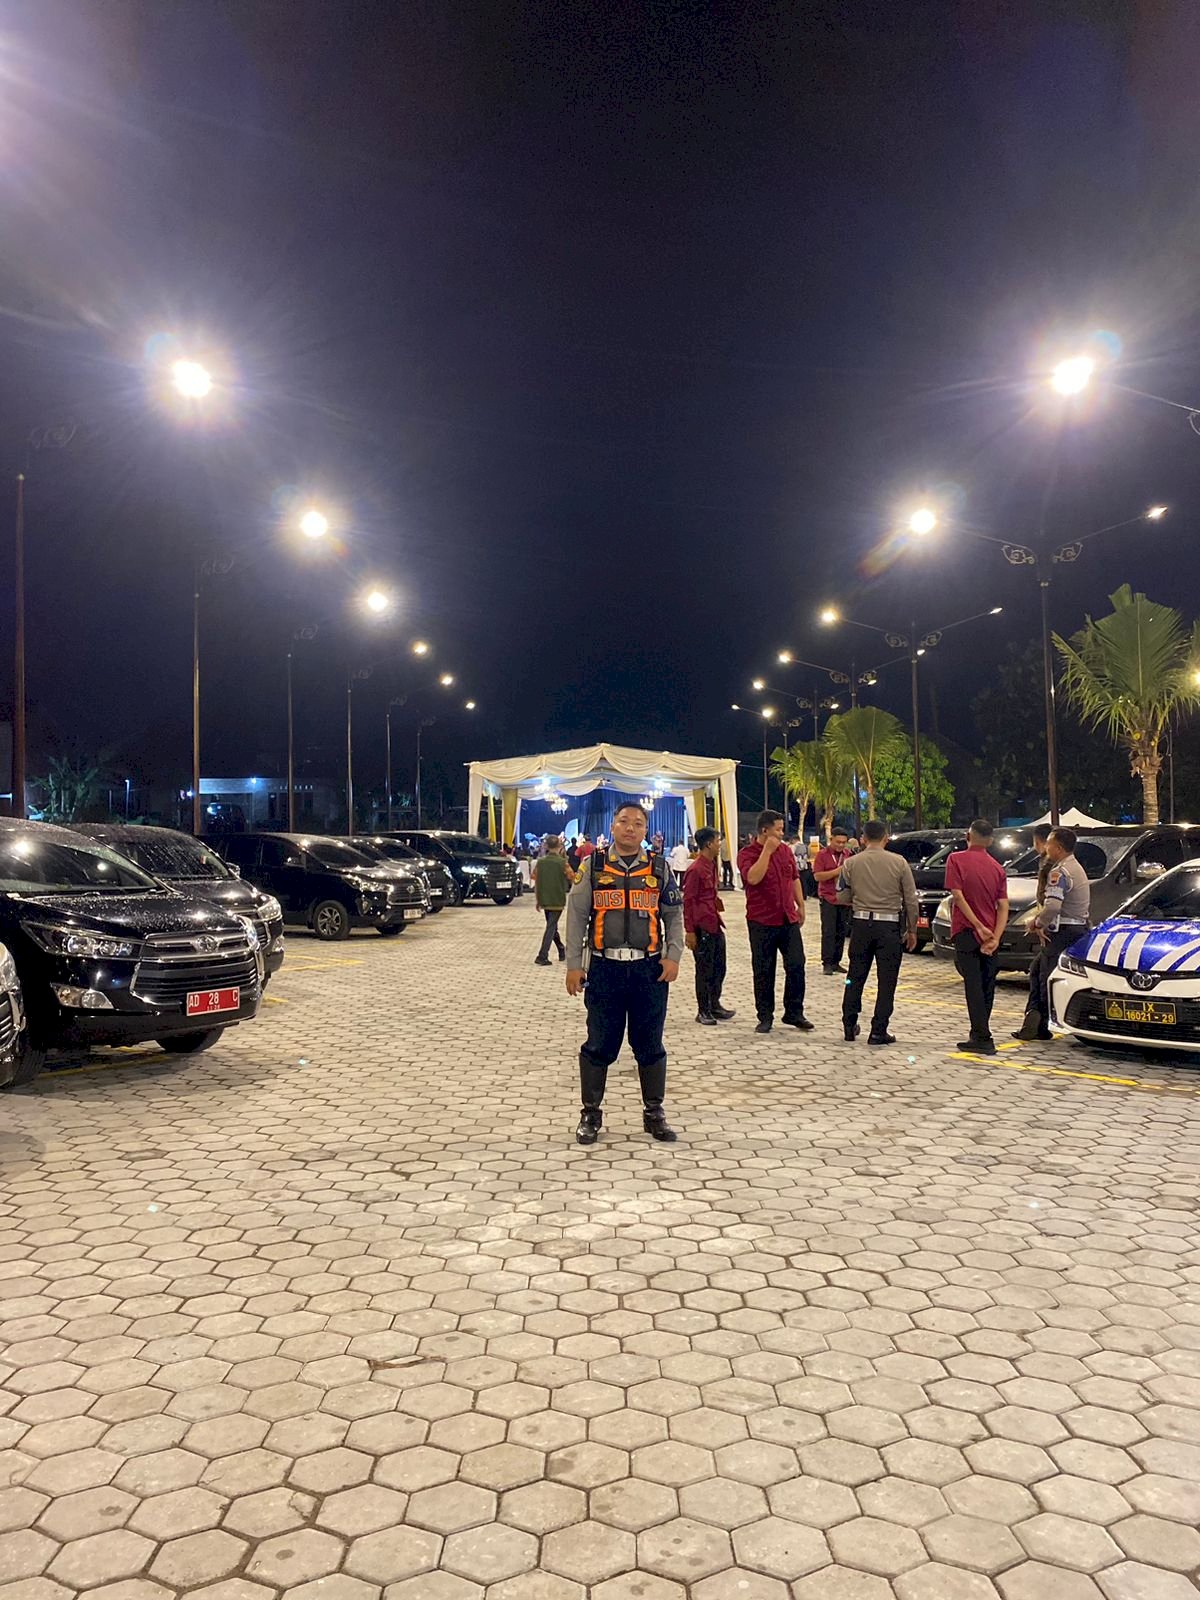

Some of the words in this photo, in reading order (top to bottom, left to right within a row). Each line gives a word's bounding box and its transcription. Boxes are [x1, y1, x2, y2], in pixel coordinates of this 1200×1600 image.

[595, 891, 623, 907] DIS
[632, 891, 657, 908] HUB
[189, 995, 200, 1007] AD
[209, 992, 219, 1005] 28
[232, 990, 238, 1001] C
[1143, 1002, 1155, 1012] IX
[1161, 1014, 1174, 1023] 29
